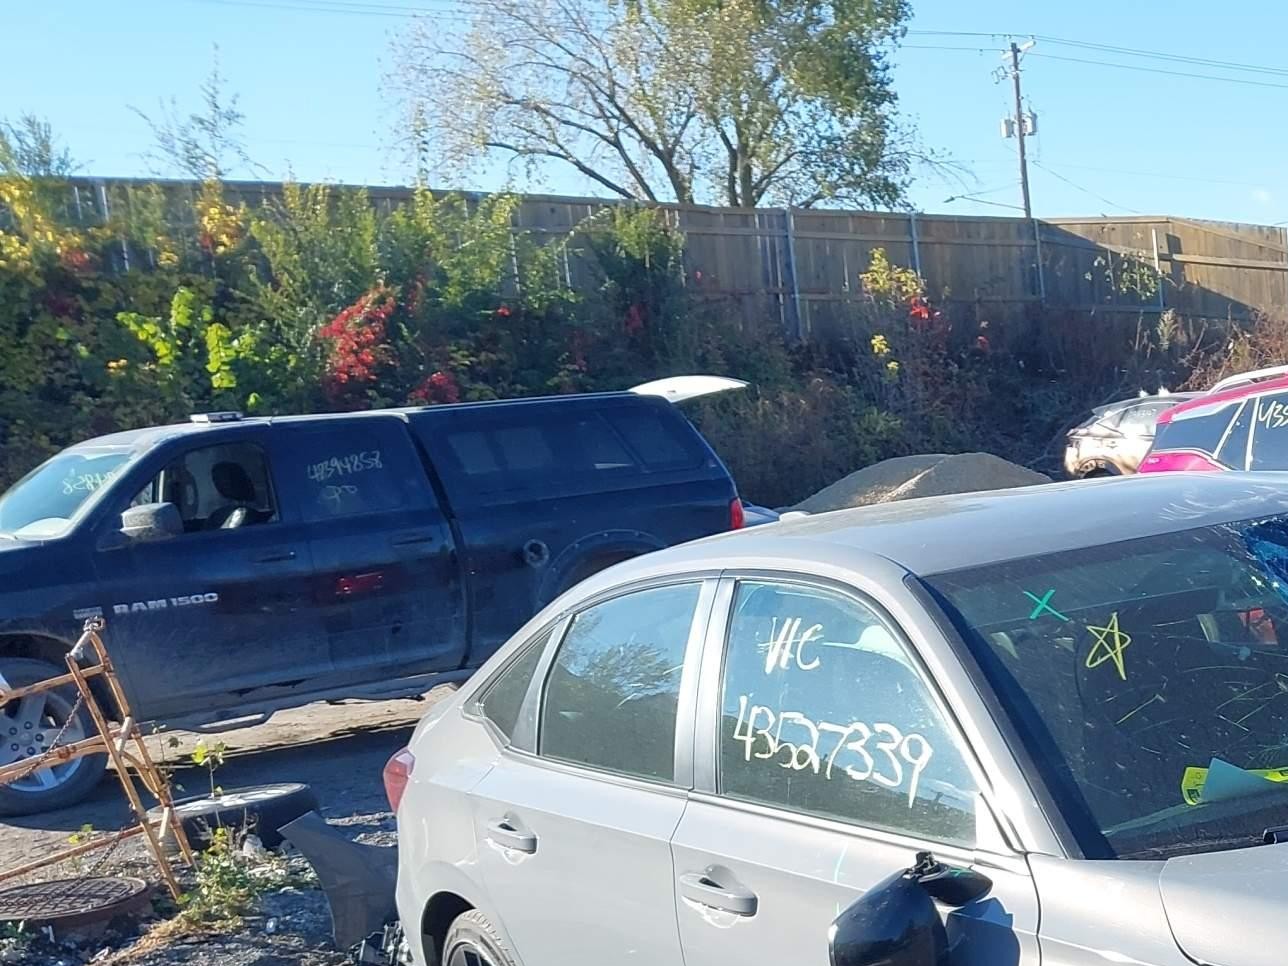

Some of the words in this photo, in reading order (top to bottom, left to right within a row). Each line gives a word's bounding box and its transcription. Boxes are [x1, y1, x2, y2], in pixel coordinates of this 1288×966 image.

[113, 599, 168, 614] RAM
[170, 592, 219, 607] 1500
[732, 695, 934, 809] 43527339
